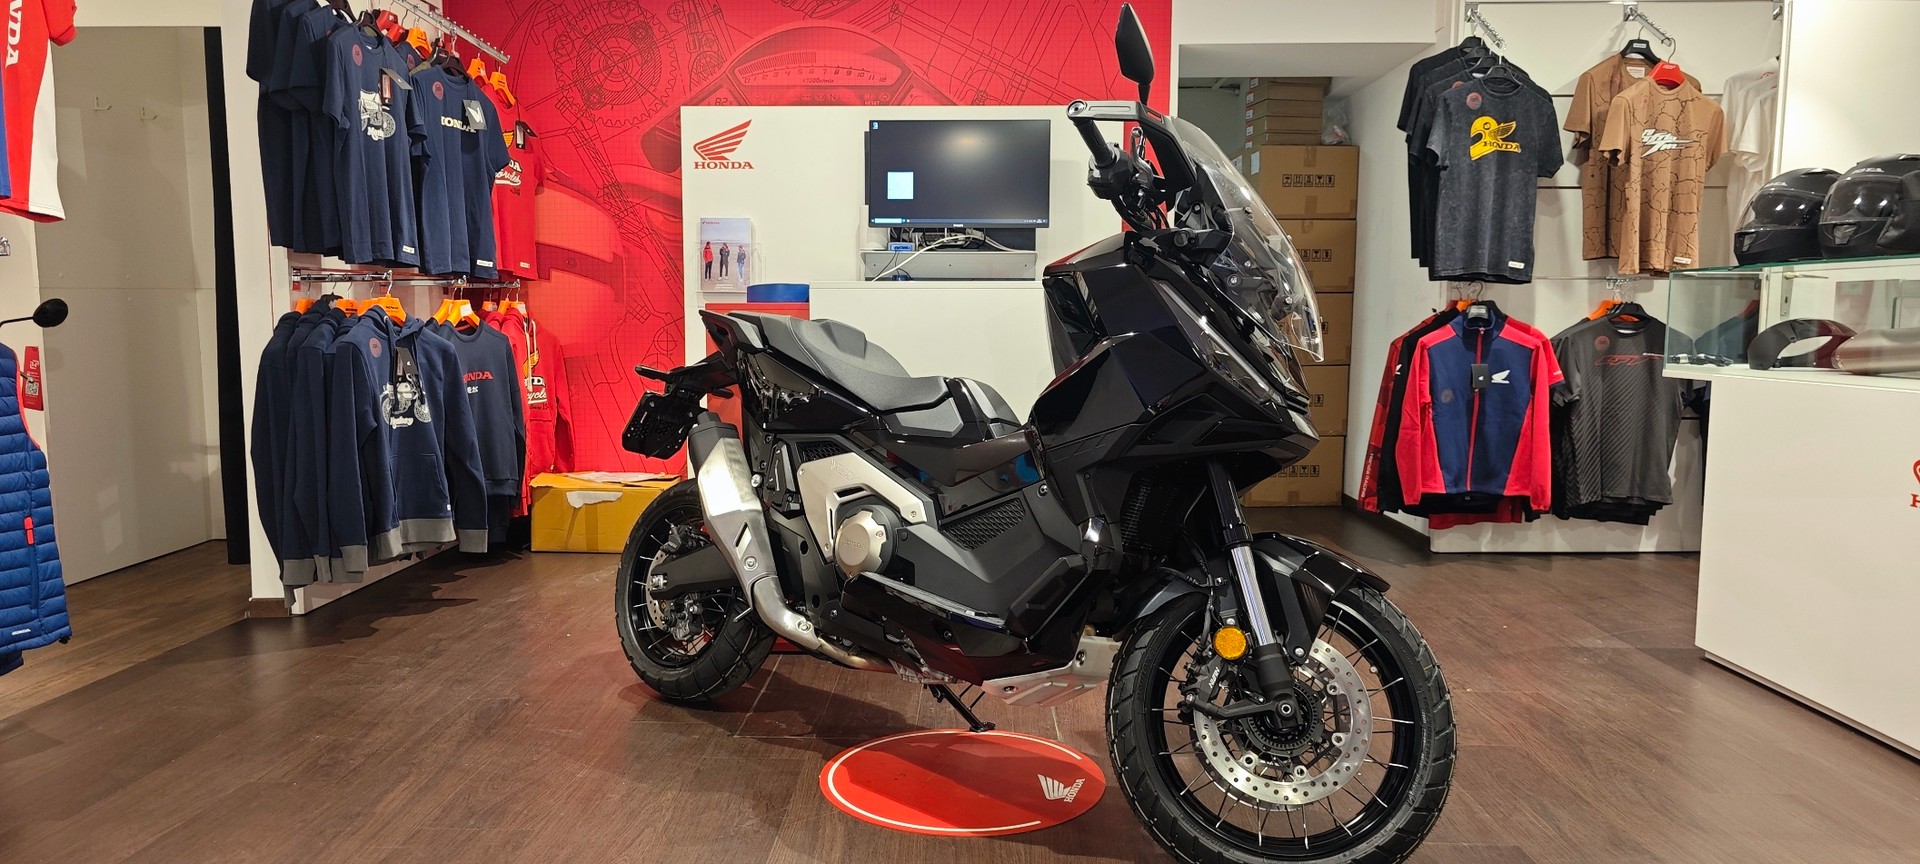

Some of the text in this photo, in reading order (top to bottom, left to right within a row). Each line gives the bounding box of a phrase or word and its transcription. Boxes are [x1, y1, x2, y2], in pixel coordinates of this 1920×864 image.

[1483, 141, 1520, 151] HONDA
[693, 161, 755, 170] HONDA
[1064, 779, 1085, 802] HONDA
